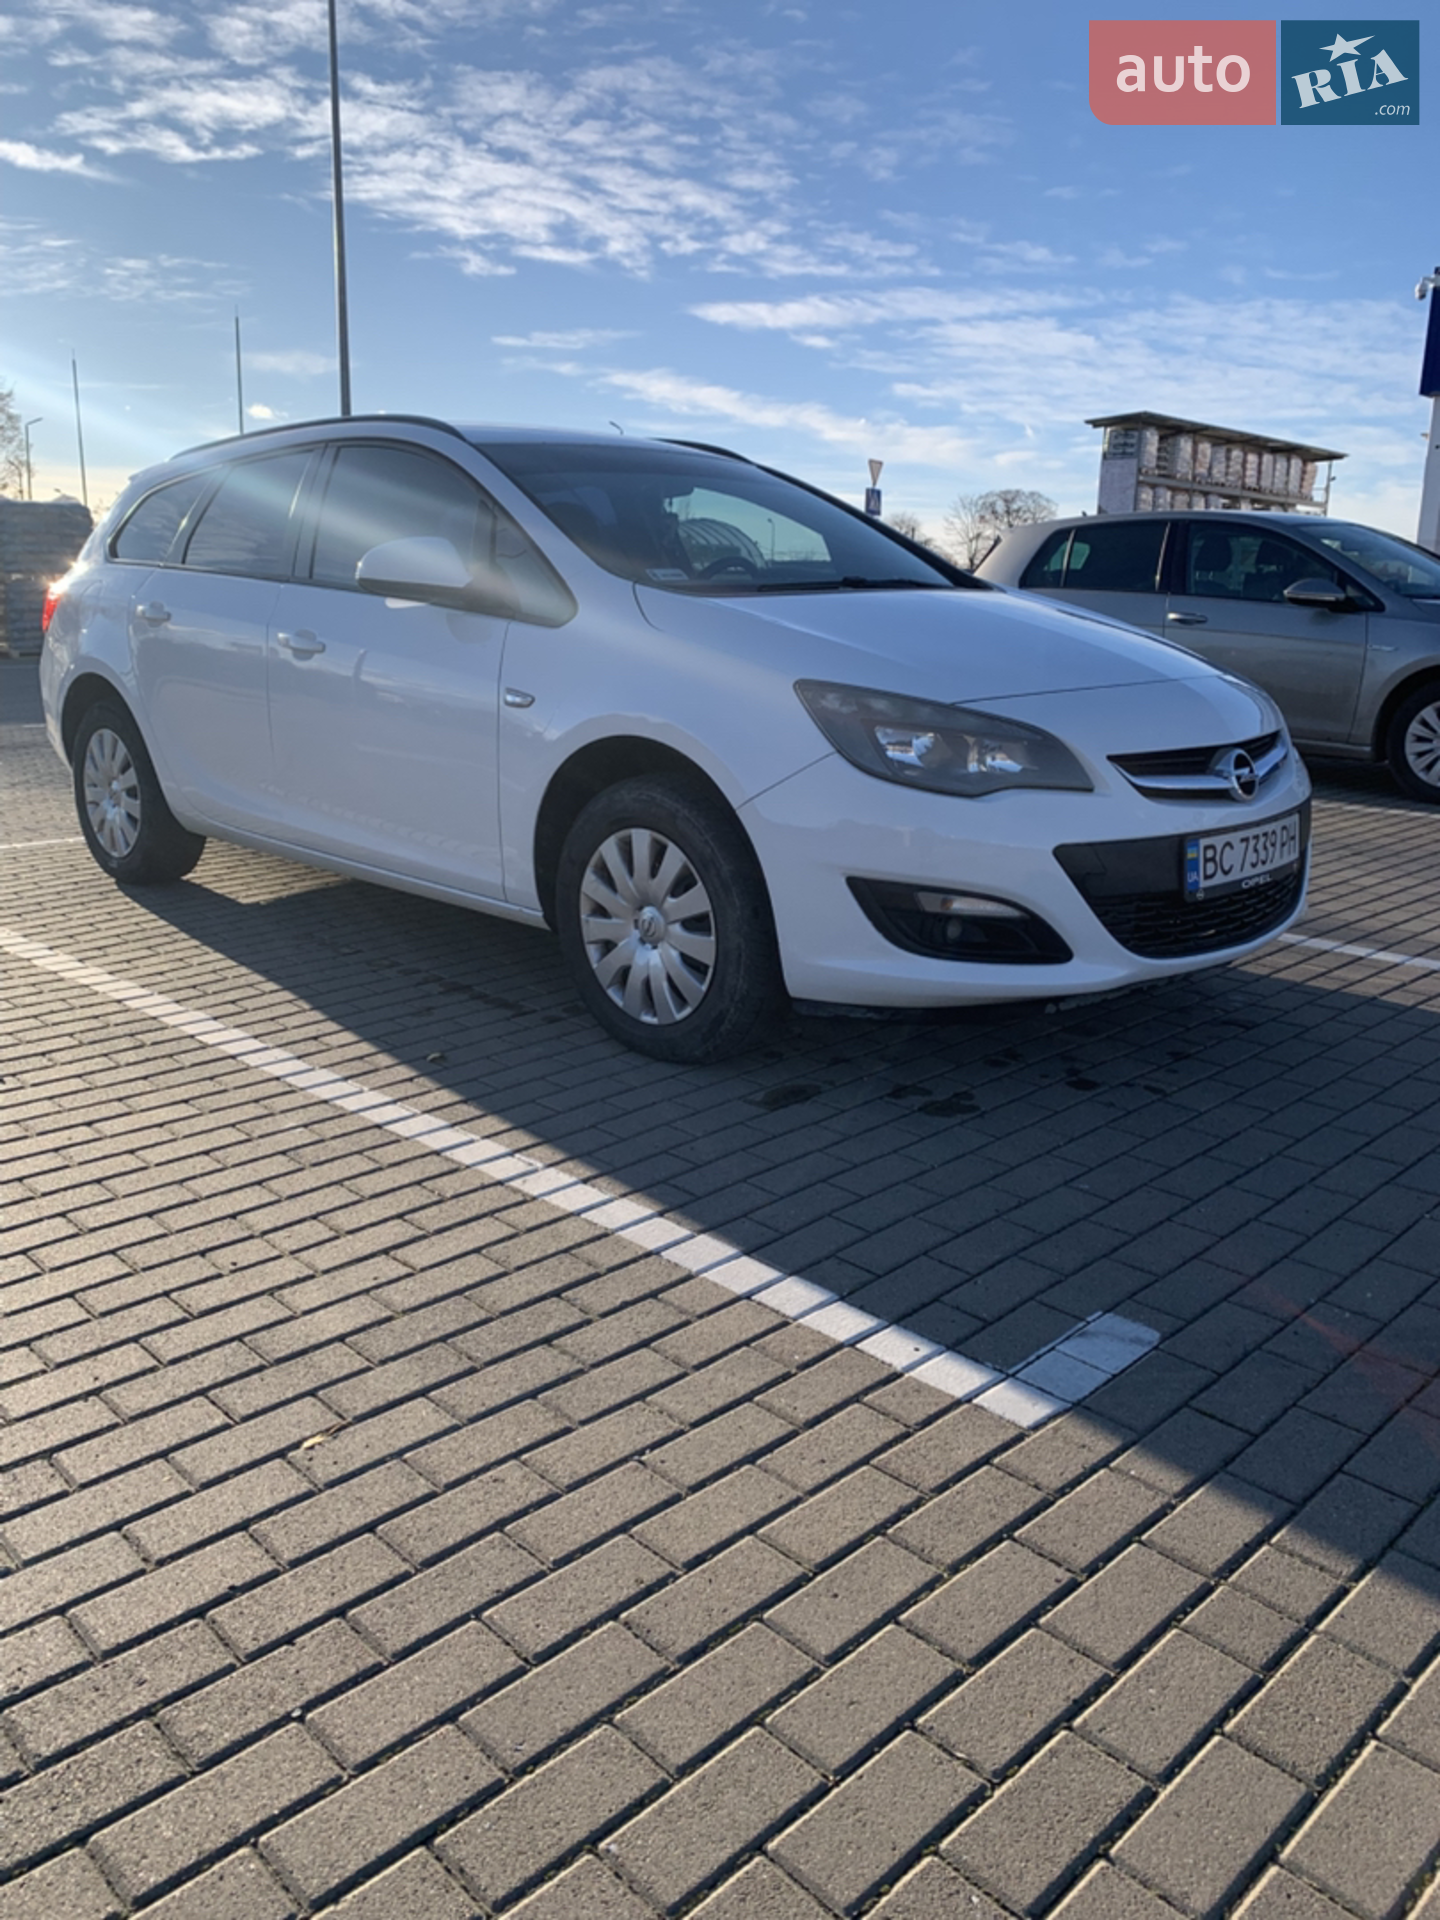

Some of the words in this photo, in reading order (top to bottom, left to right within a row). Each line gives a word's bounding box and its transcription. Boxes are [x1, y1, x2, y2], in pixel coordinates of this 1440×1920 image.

[1203, 841, 1234, 880] BC
[1240, 829, 1277, 872] 7339
[1280, 821, 1296, 859] PH
[1188, 871, 1199, 883] UA
